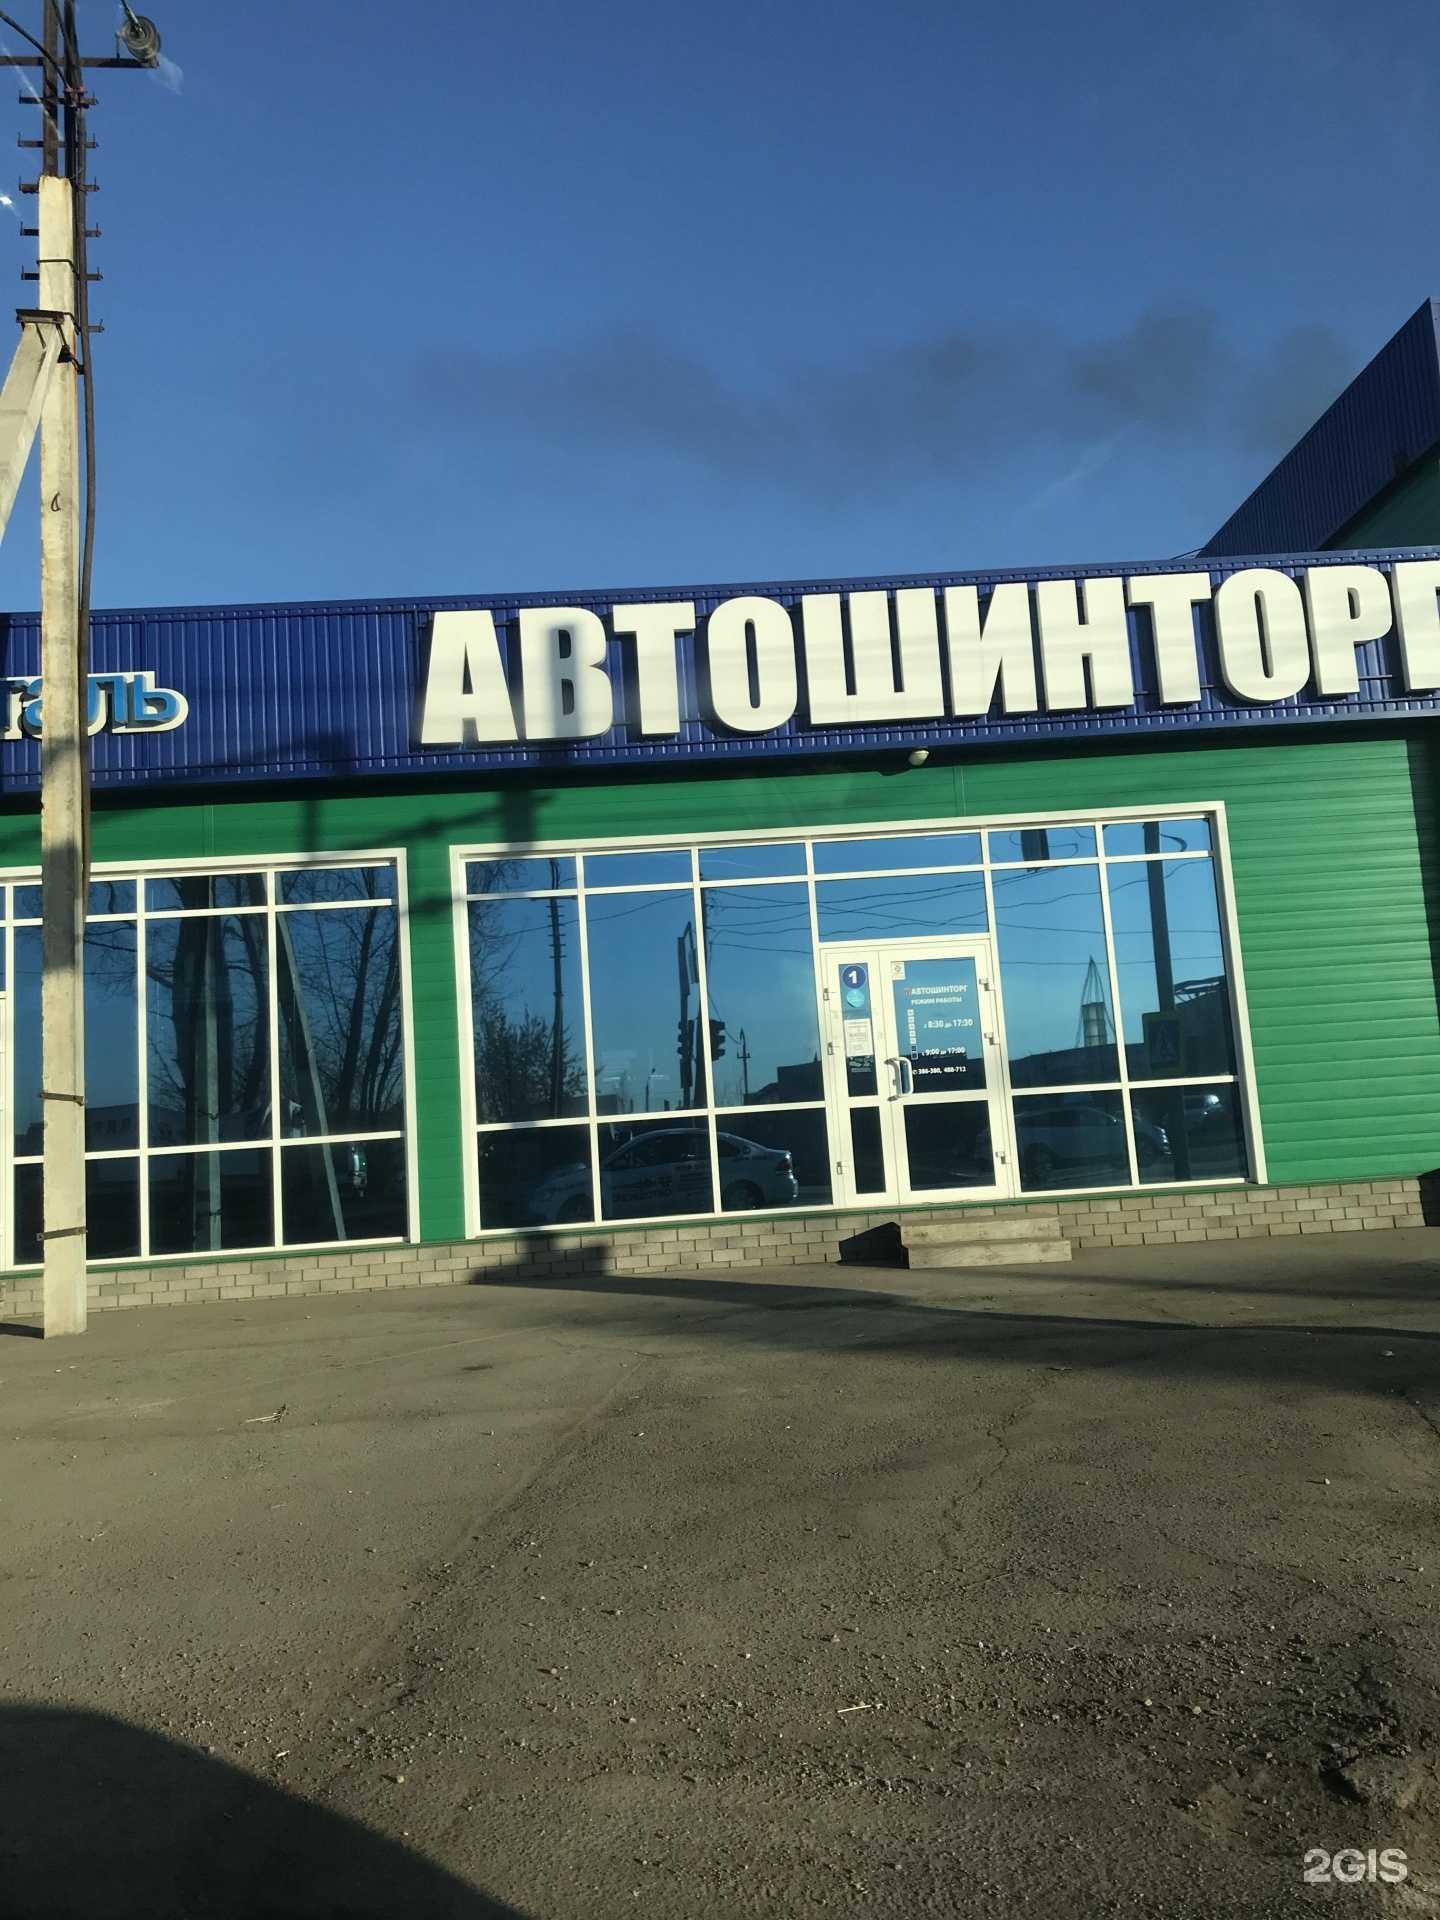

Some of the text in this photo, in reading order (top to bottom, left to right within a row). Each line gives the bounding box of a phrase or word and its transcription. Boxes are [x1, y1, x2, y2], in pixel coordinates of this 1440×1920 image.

[420, 561, 1440, 745] АВТОШИНТОРГ
[848, 970, 858, 984] 1
[911, 985, 968, 995] АВТОШИНТОРГ
[928, 1020, 944, 1028] 8:30
[953, 1018, 974, 1027] 17:30
[925, 1048, 940, 1056] 9:00
[947, 1046, 966, 1054] 17:00
